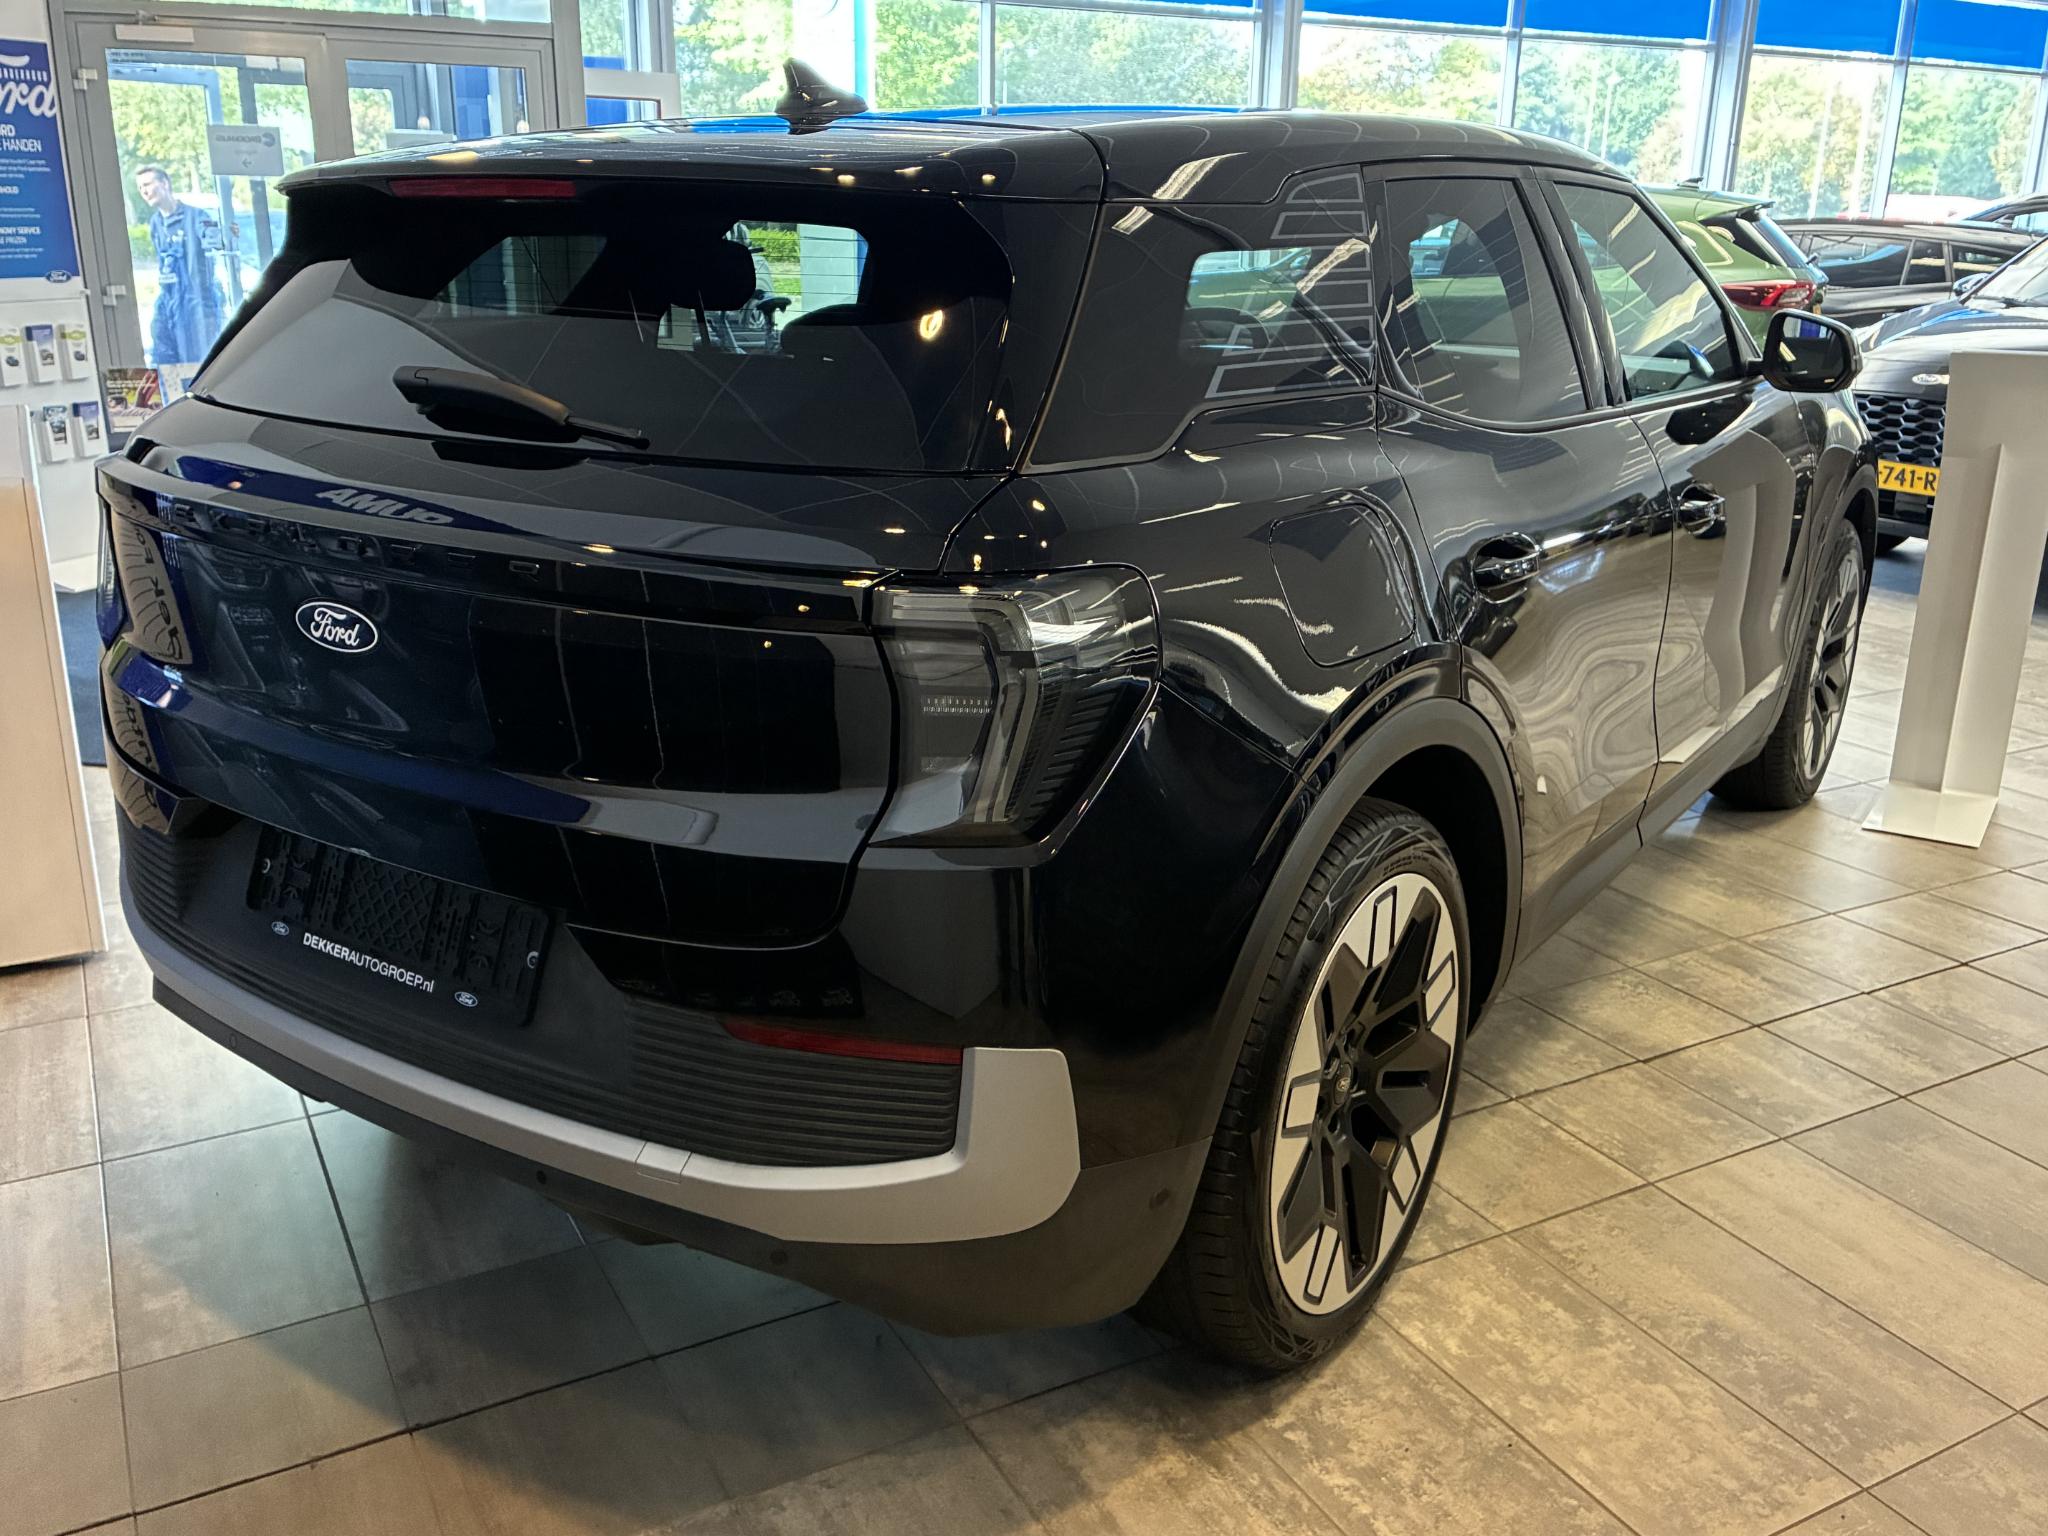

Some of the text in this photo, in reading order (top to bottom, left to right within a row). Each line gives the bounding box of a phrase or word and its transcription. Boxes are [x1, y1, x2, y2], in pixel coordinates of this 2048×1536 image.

[2, 138, 42, 152] HANDEN
[310, 606, 361, 648] Ford
[303, 932, 435, 993] DEKKERAUTOGROEP.nl
